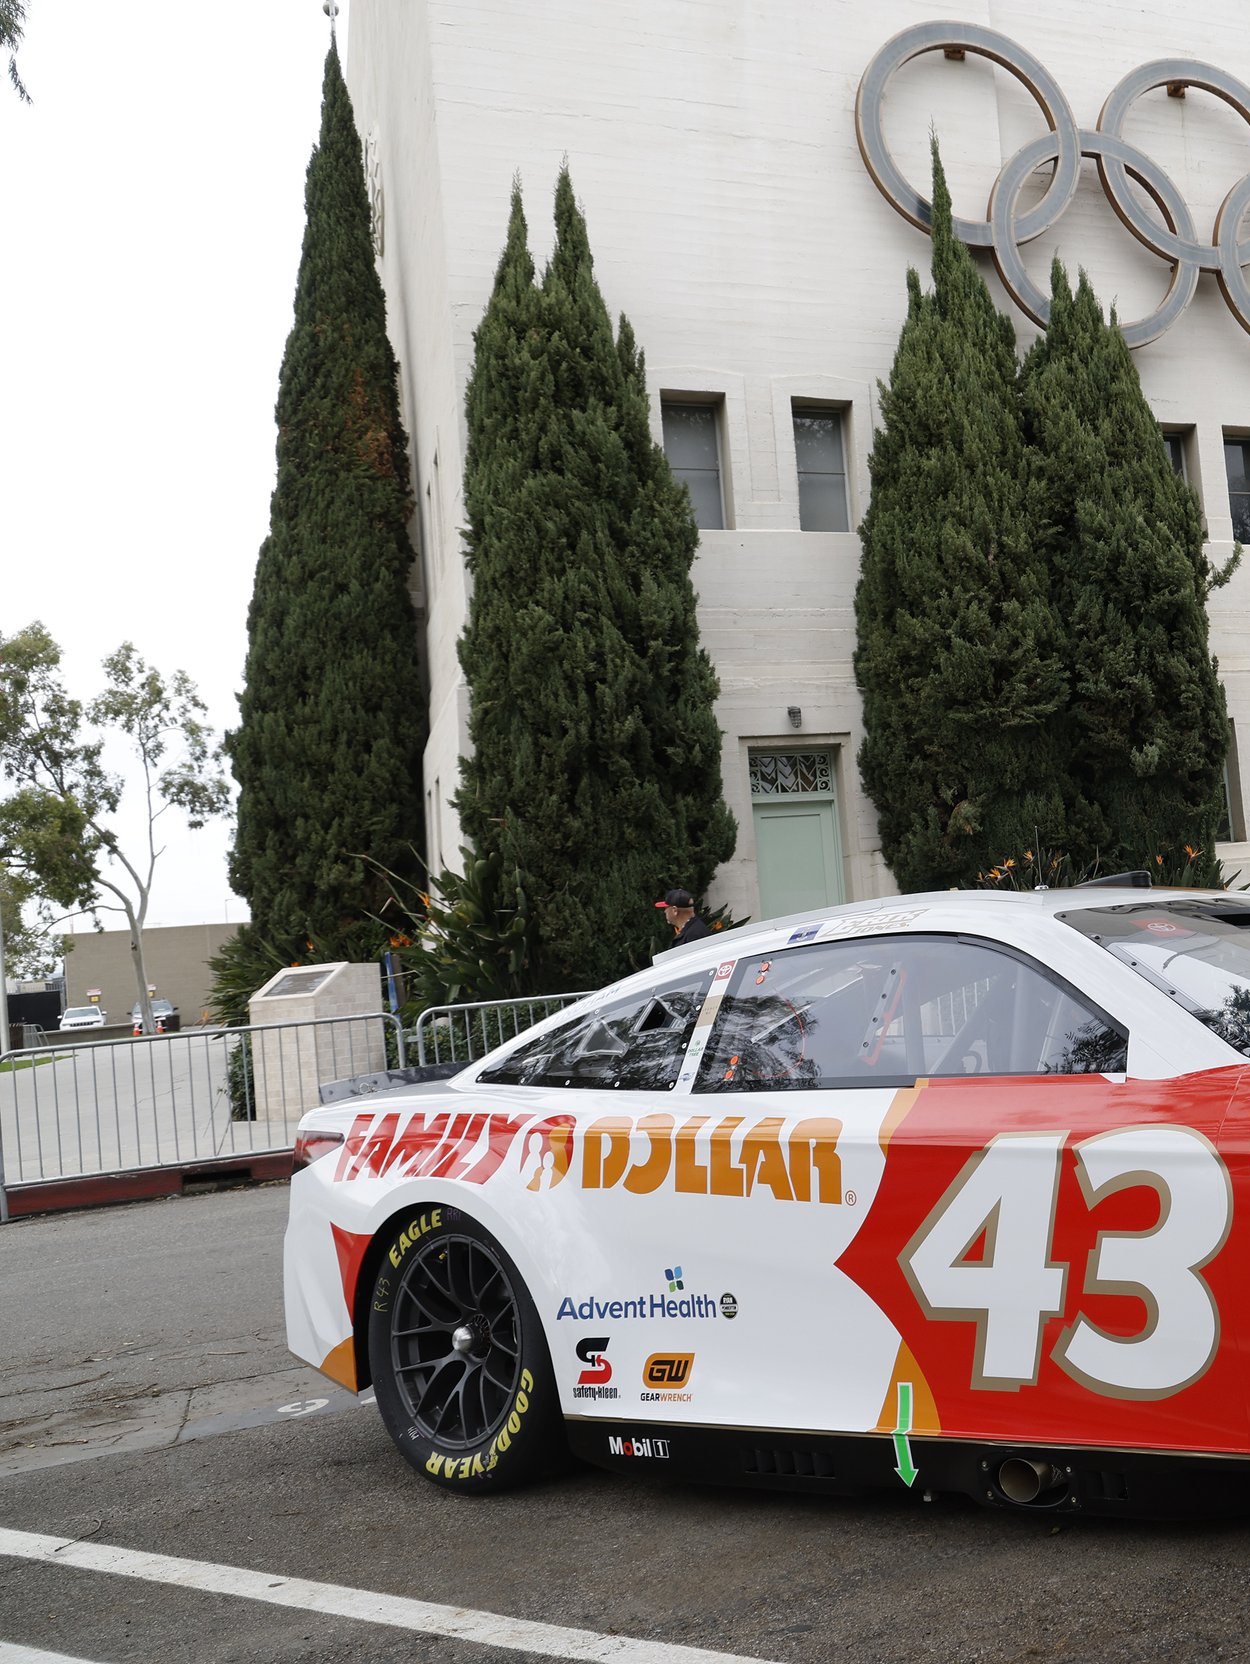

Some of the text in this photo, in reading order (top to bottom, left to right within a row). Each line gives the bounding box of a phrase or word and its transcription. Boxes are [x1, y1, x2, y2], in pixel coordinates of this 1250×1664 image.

[334, 1113, 843, 1204] FAMILY DOLLAR
[388, 1208, 442, 1269] EAGLE
[896, 1124, 1234, 1400] 43
[640, 1392, 692, 1402] GEARWRENCH
[608, 1436, 653, 1457] Mobil
